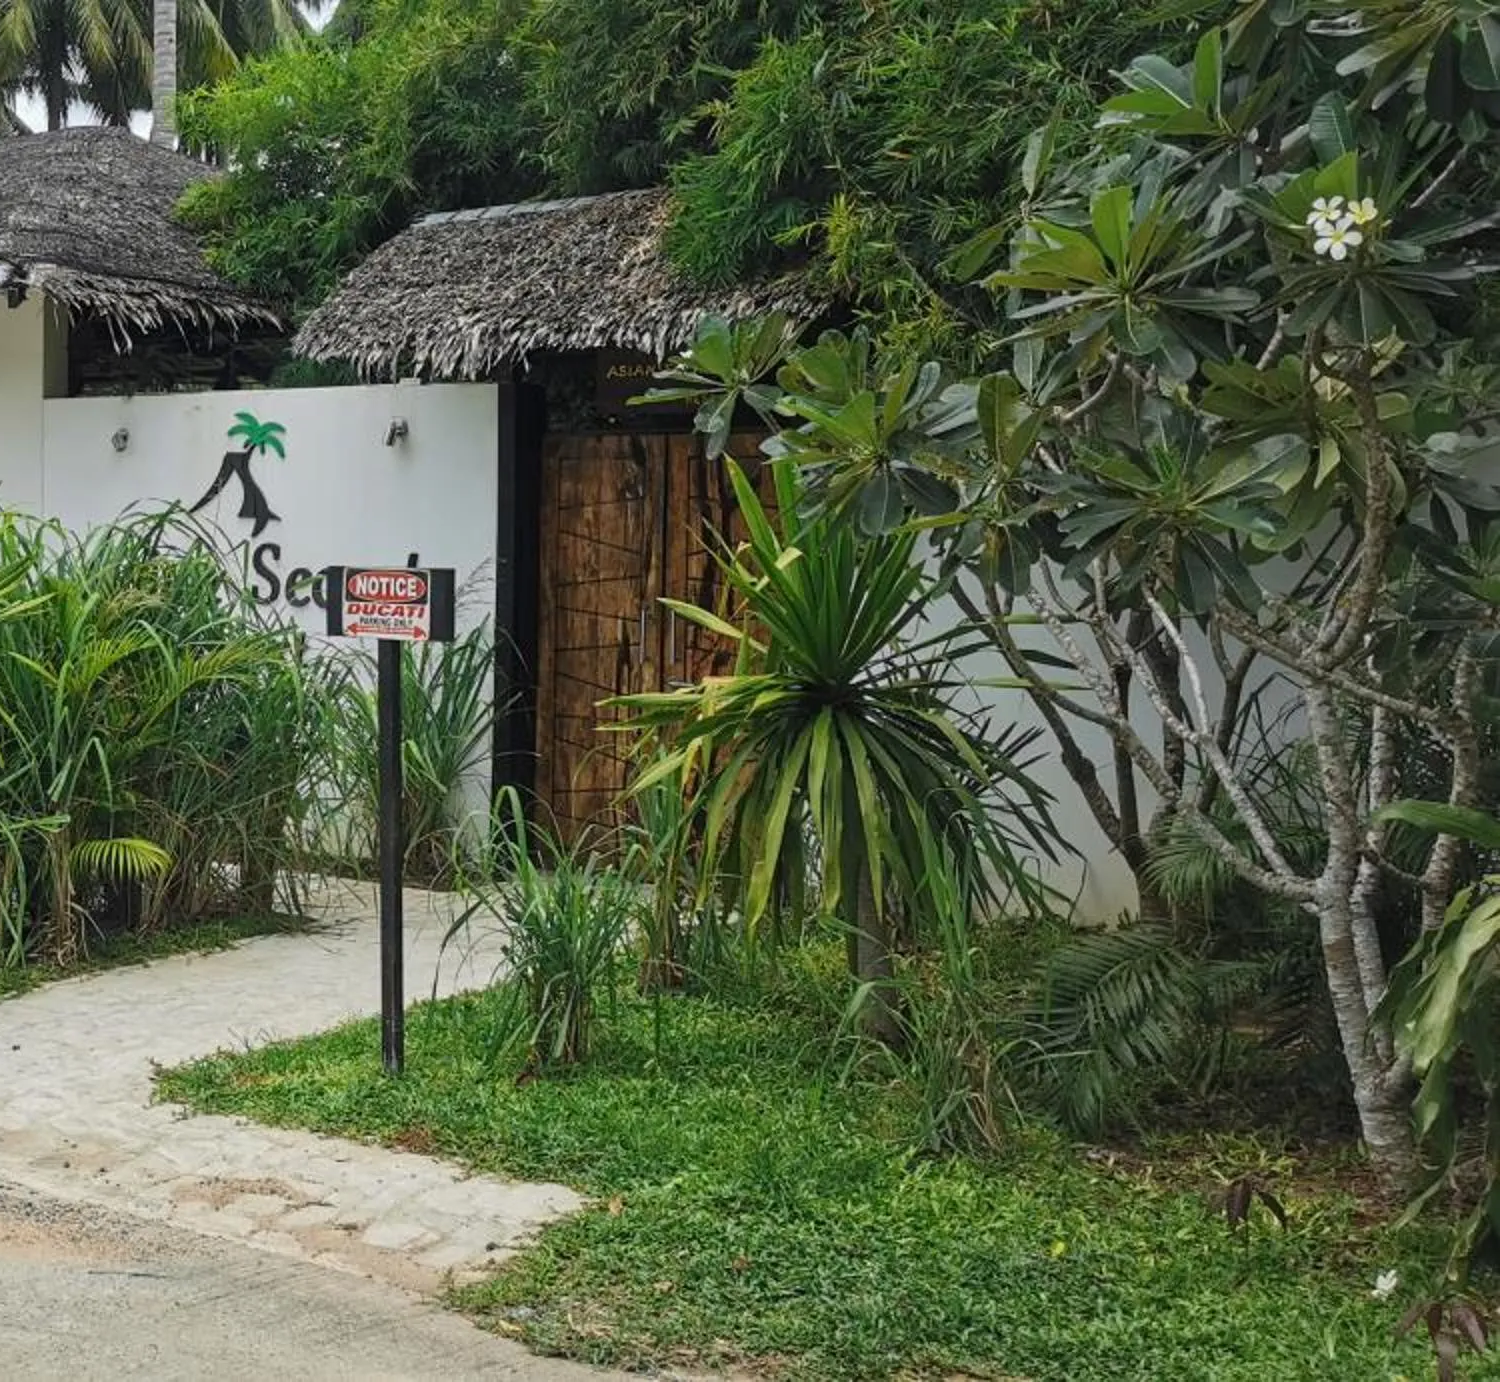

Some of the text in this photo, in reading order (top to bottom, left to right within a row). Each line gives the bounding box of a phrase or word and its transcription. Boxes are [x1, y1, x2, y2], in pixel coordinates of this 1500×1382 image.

[606, 364, 656, 379] ASIAN
[355, 575, 417, 598] NOTICE
[347, 603, 425, 619] DUCATI
[359, 617, 414, 627] PARKING ONLY
